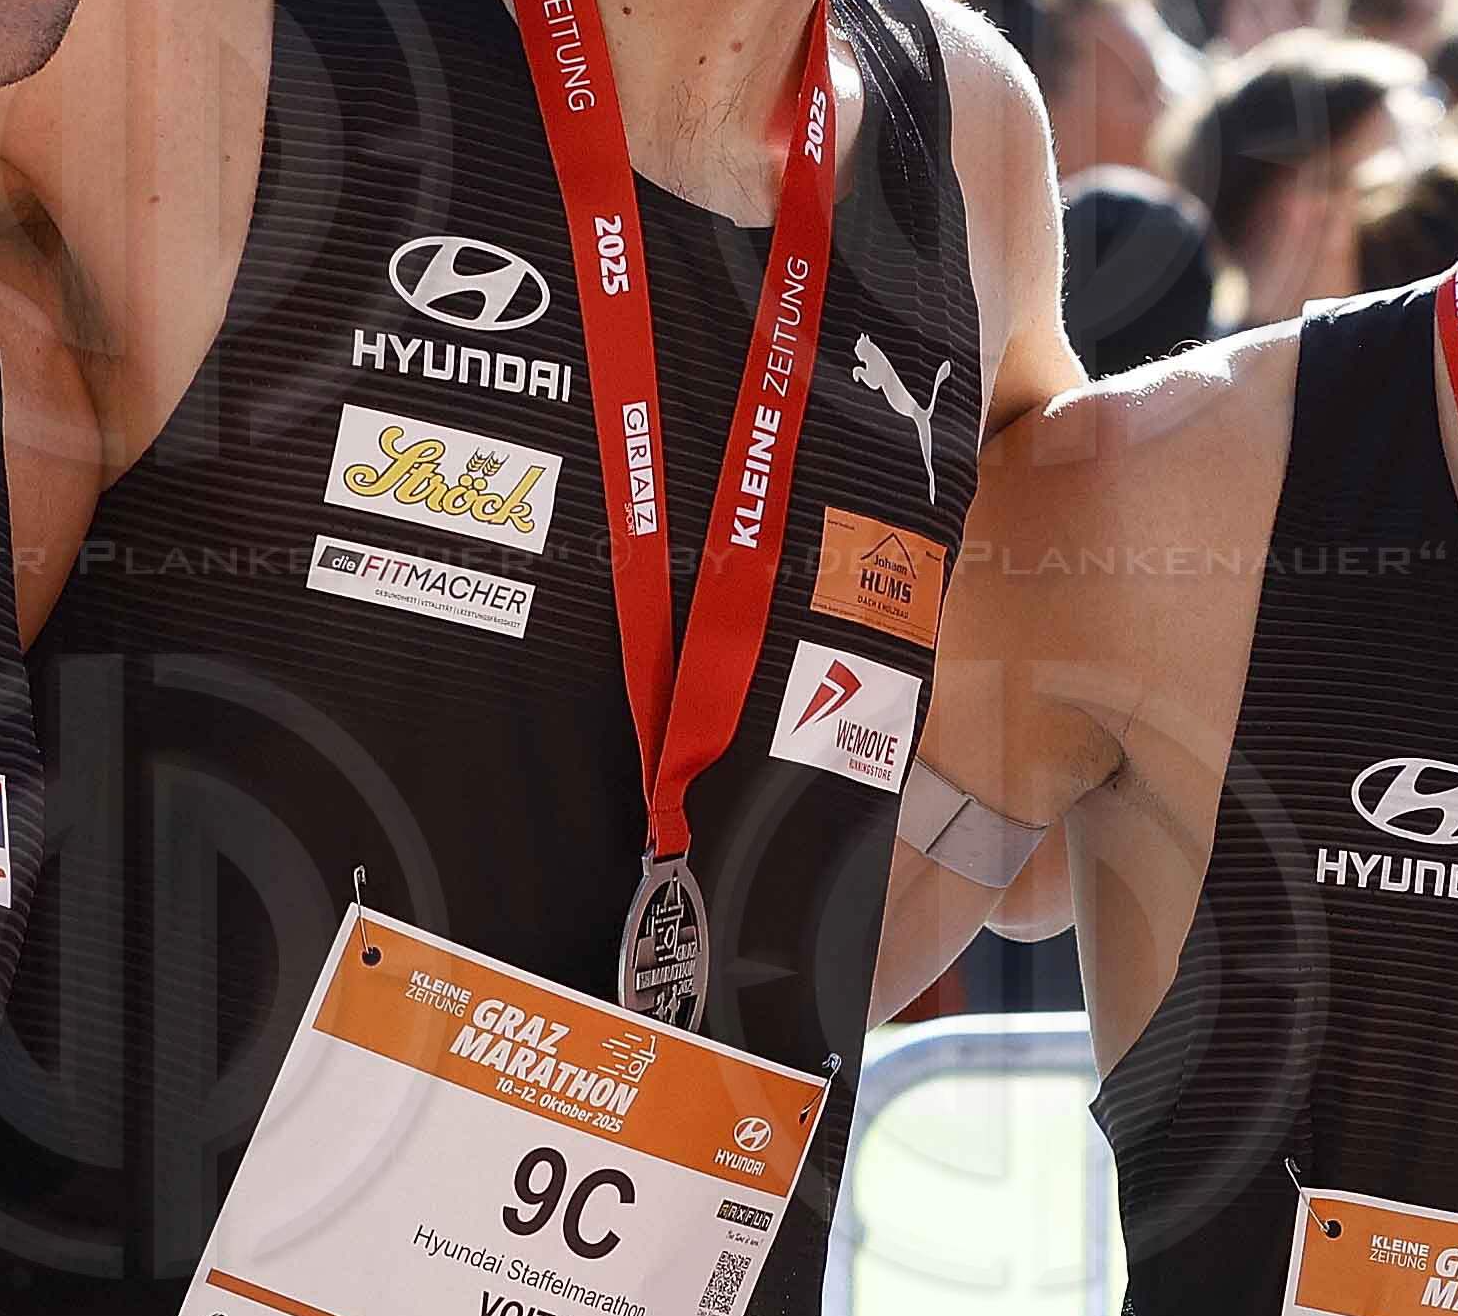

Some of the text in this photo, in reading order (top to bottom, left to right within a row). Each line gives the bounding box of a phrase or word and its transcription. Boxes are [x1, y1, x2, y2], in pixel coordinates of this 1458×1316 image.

[804, 86, 827, 165] 2025
[593, 214, 629, 296] 2025
[352, 329, 572, 402] HYUNDAI
[730, 256, 809, 550] KLEINE ZEITUNG
[343, 425, 545, 534] Ströck
[623, 401, 657, 536] GRAZ
[331, 554, 528, 615] die FITMACHER
[859, 567, 913, 604] HUMS
[835, 717, 899, 767] WEMOVE
[405, 984, 466, 1018] ZEITUNG
[410, 971, 472, 1004] KLEINE
[472, 998, 571, 1055] GRAZ
[449, 1024, 639, 1116] MARATHON
[539, 1094, 593, 1124] Oktober
[592, 1112, 624, 1133] 2025
[714, 1148, 766, 1177] HYUNDAI
[502, 1146, 637, 1260] 9C
[413, 1224, 505, 1275] Hyundai
[1369, 1247, 1427, 1271] ZEITUNG
[1371, 1234, 1430, 1258] KLEINE
